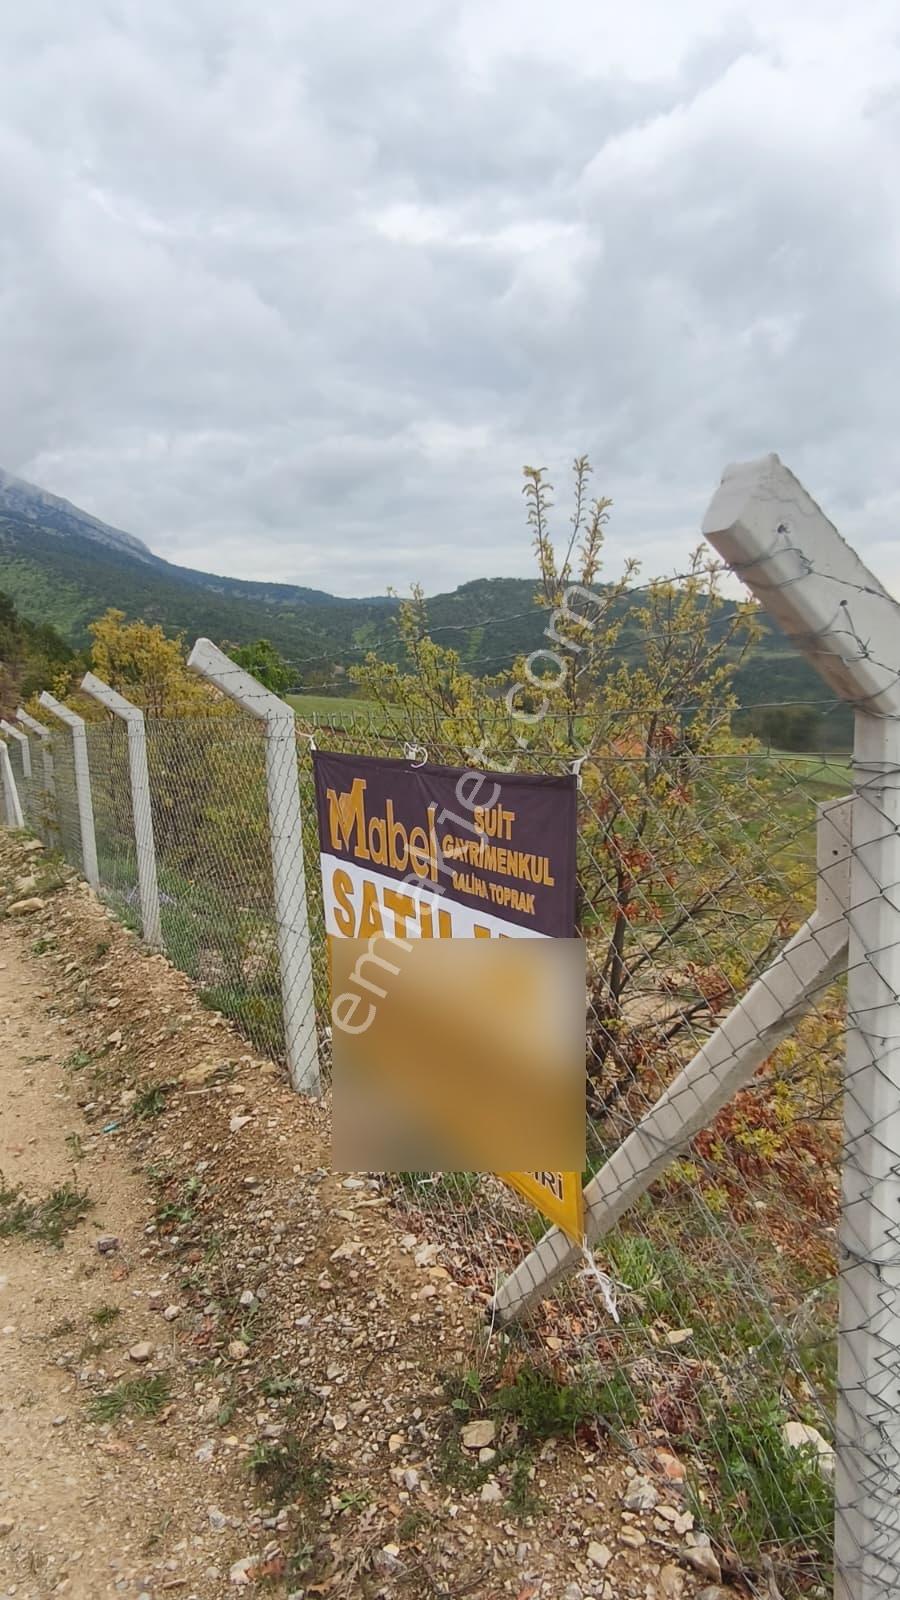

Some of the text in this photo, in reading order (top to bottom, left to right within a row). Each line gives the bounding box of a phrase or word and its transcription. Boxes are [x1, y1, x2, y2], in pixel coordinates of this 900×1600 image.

[326, 777, 439, 883] Mabel
[442, 834, 555, 887] GAYRİMENKUL
[489, 882, 536, 915] TOPRAK
